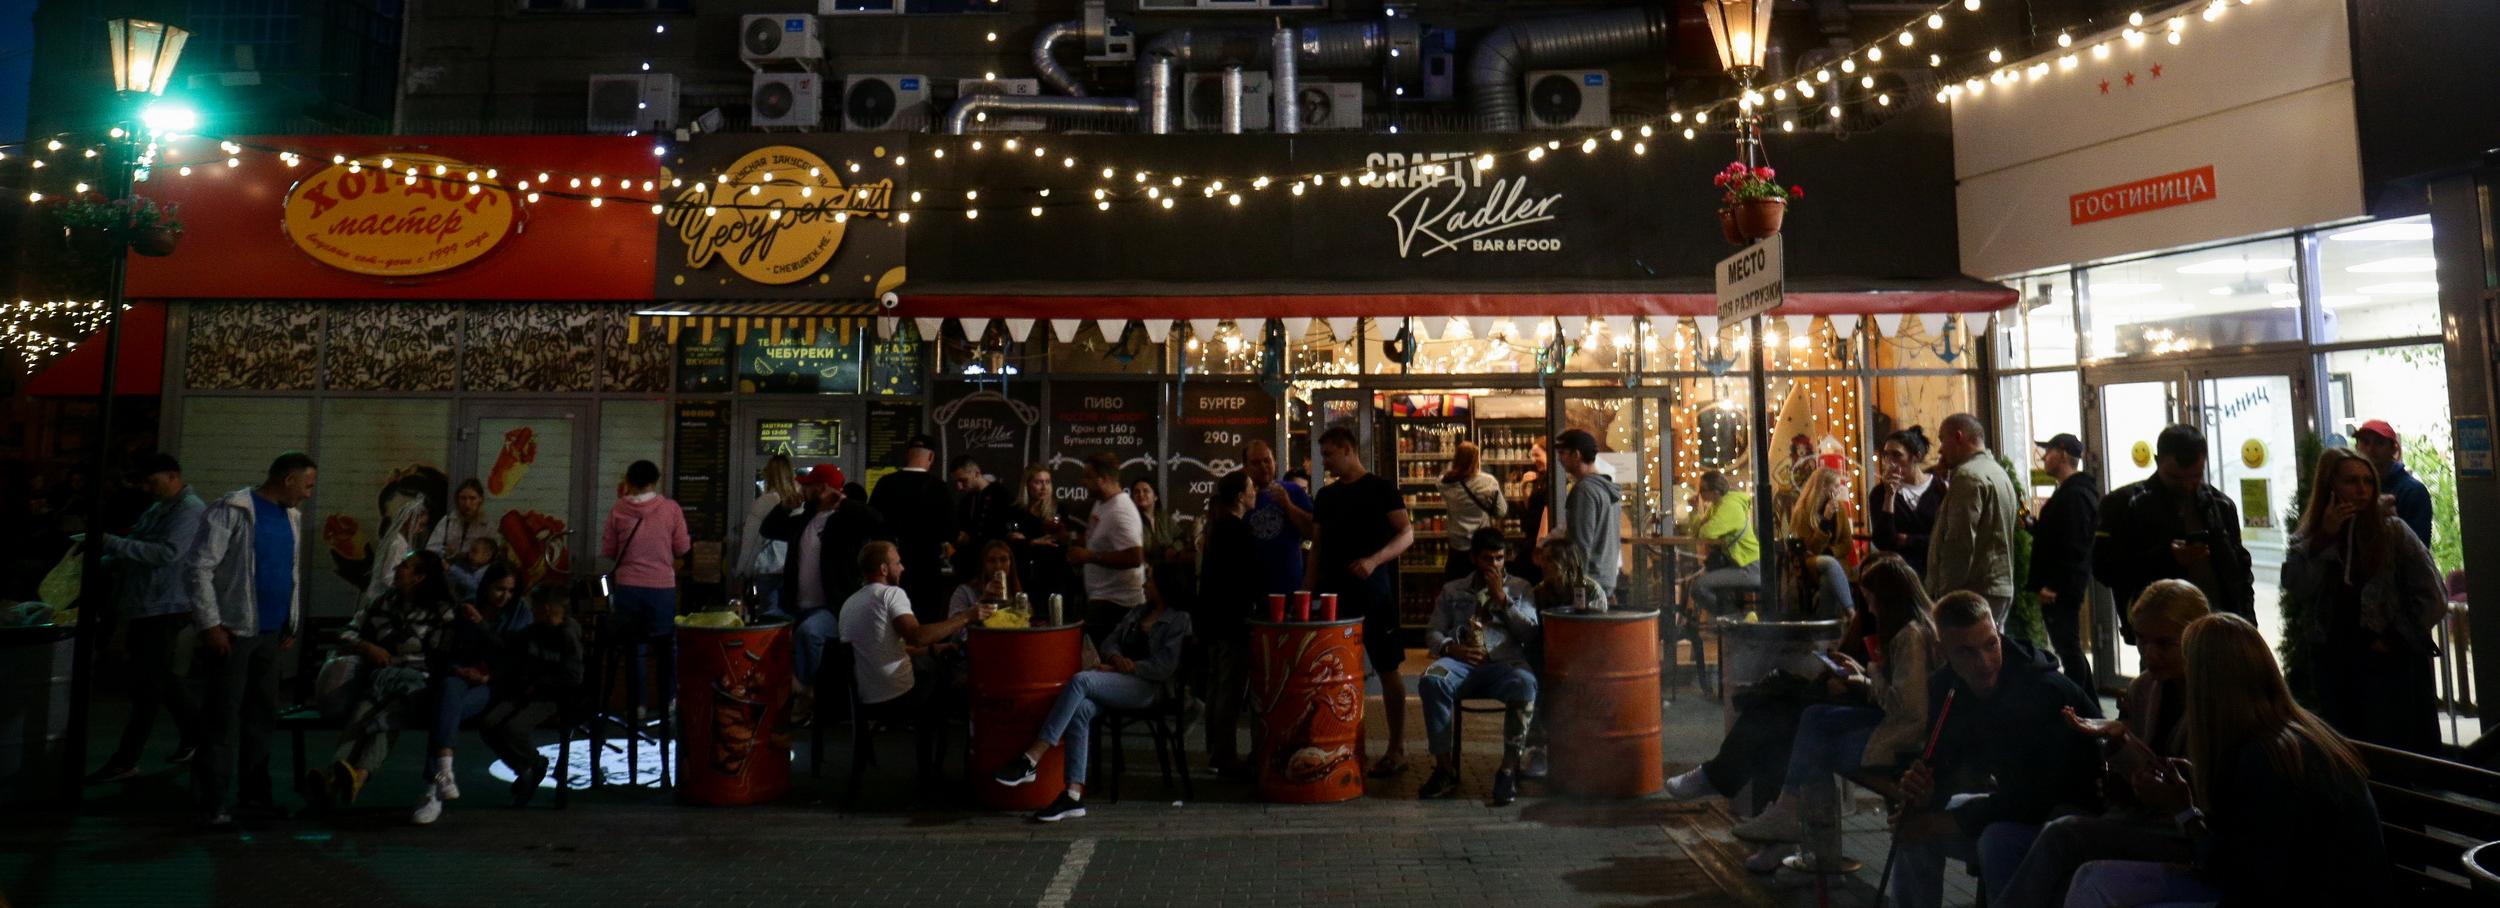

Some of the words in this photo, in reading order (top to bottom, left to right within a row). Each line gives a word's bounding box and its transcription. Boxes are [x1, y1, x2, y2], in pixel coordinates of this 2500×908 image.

[1366, 152, 1482, 188] CRAFTY
[303, 163, 497, 219] ХОТ-ДОГ
[2075, 174, 2208, 219] ГОСТИНИЦА
[328, 206, 463, 243] мастер
[1387, 175, 1562, 258] Radler
[1727, 248, 1766, 286] МЕСТО
[1735, 280, 1783, 316] РАЗГРУЗКИ
[766, 347, 835, 359] ЧЕБУРЕКИ
[1083, 395, 1125, 410] ПИВО
[1199, 396, 1246, 410] БУРГЕР
[1063, 434, 1102, 447] Бутылка
[1104, 437, 1115, 445] от
[1116, 435, 1135, 446] 200
[1071, 424, 1095, 435] Кран
[1096, 425, 1108, 433] от
[1110, 423, 1127, 434] 160
[1203, 430, 1229, 444] 290
[1232, 432, 1242, 447] р
